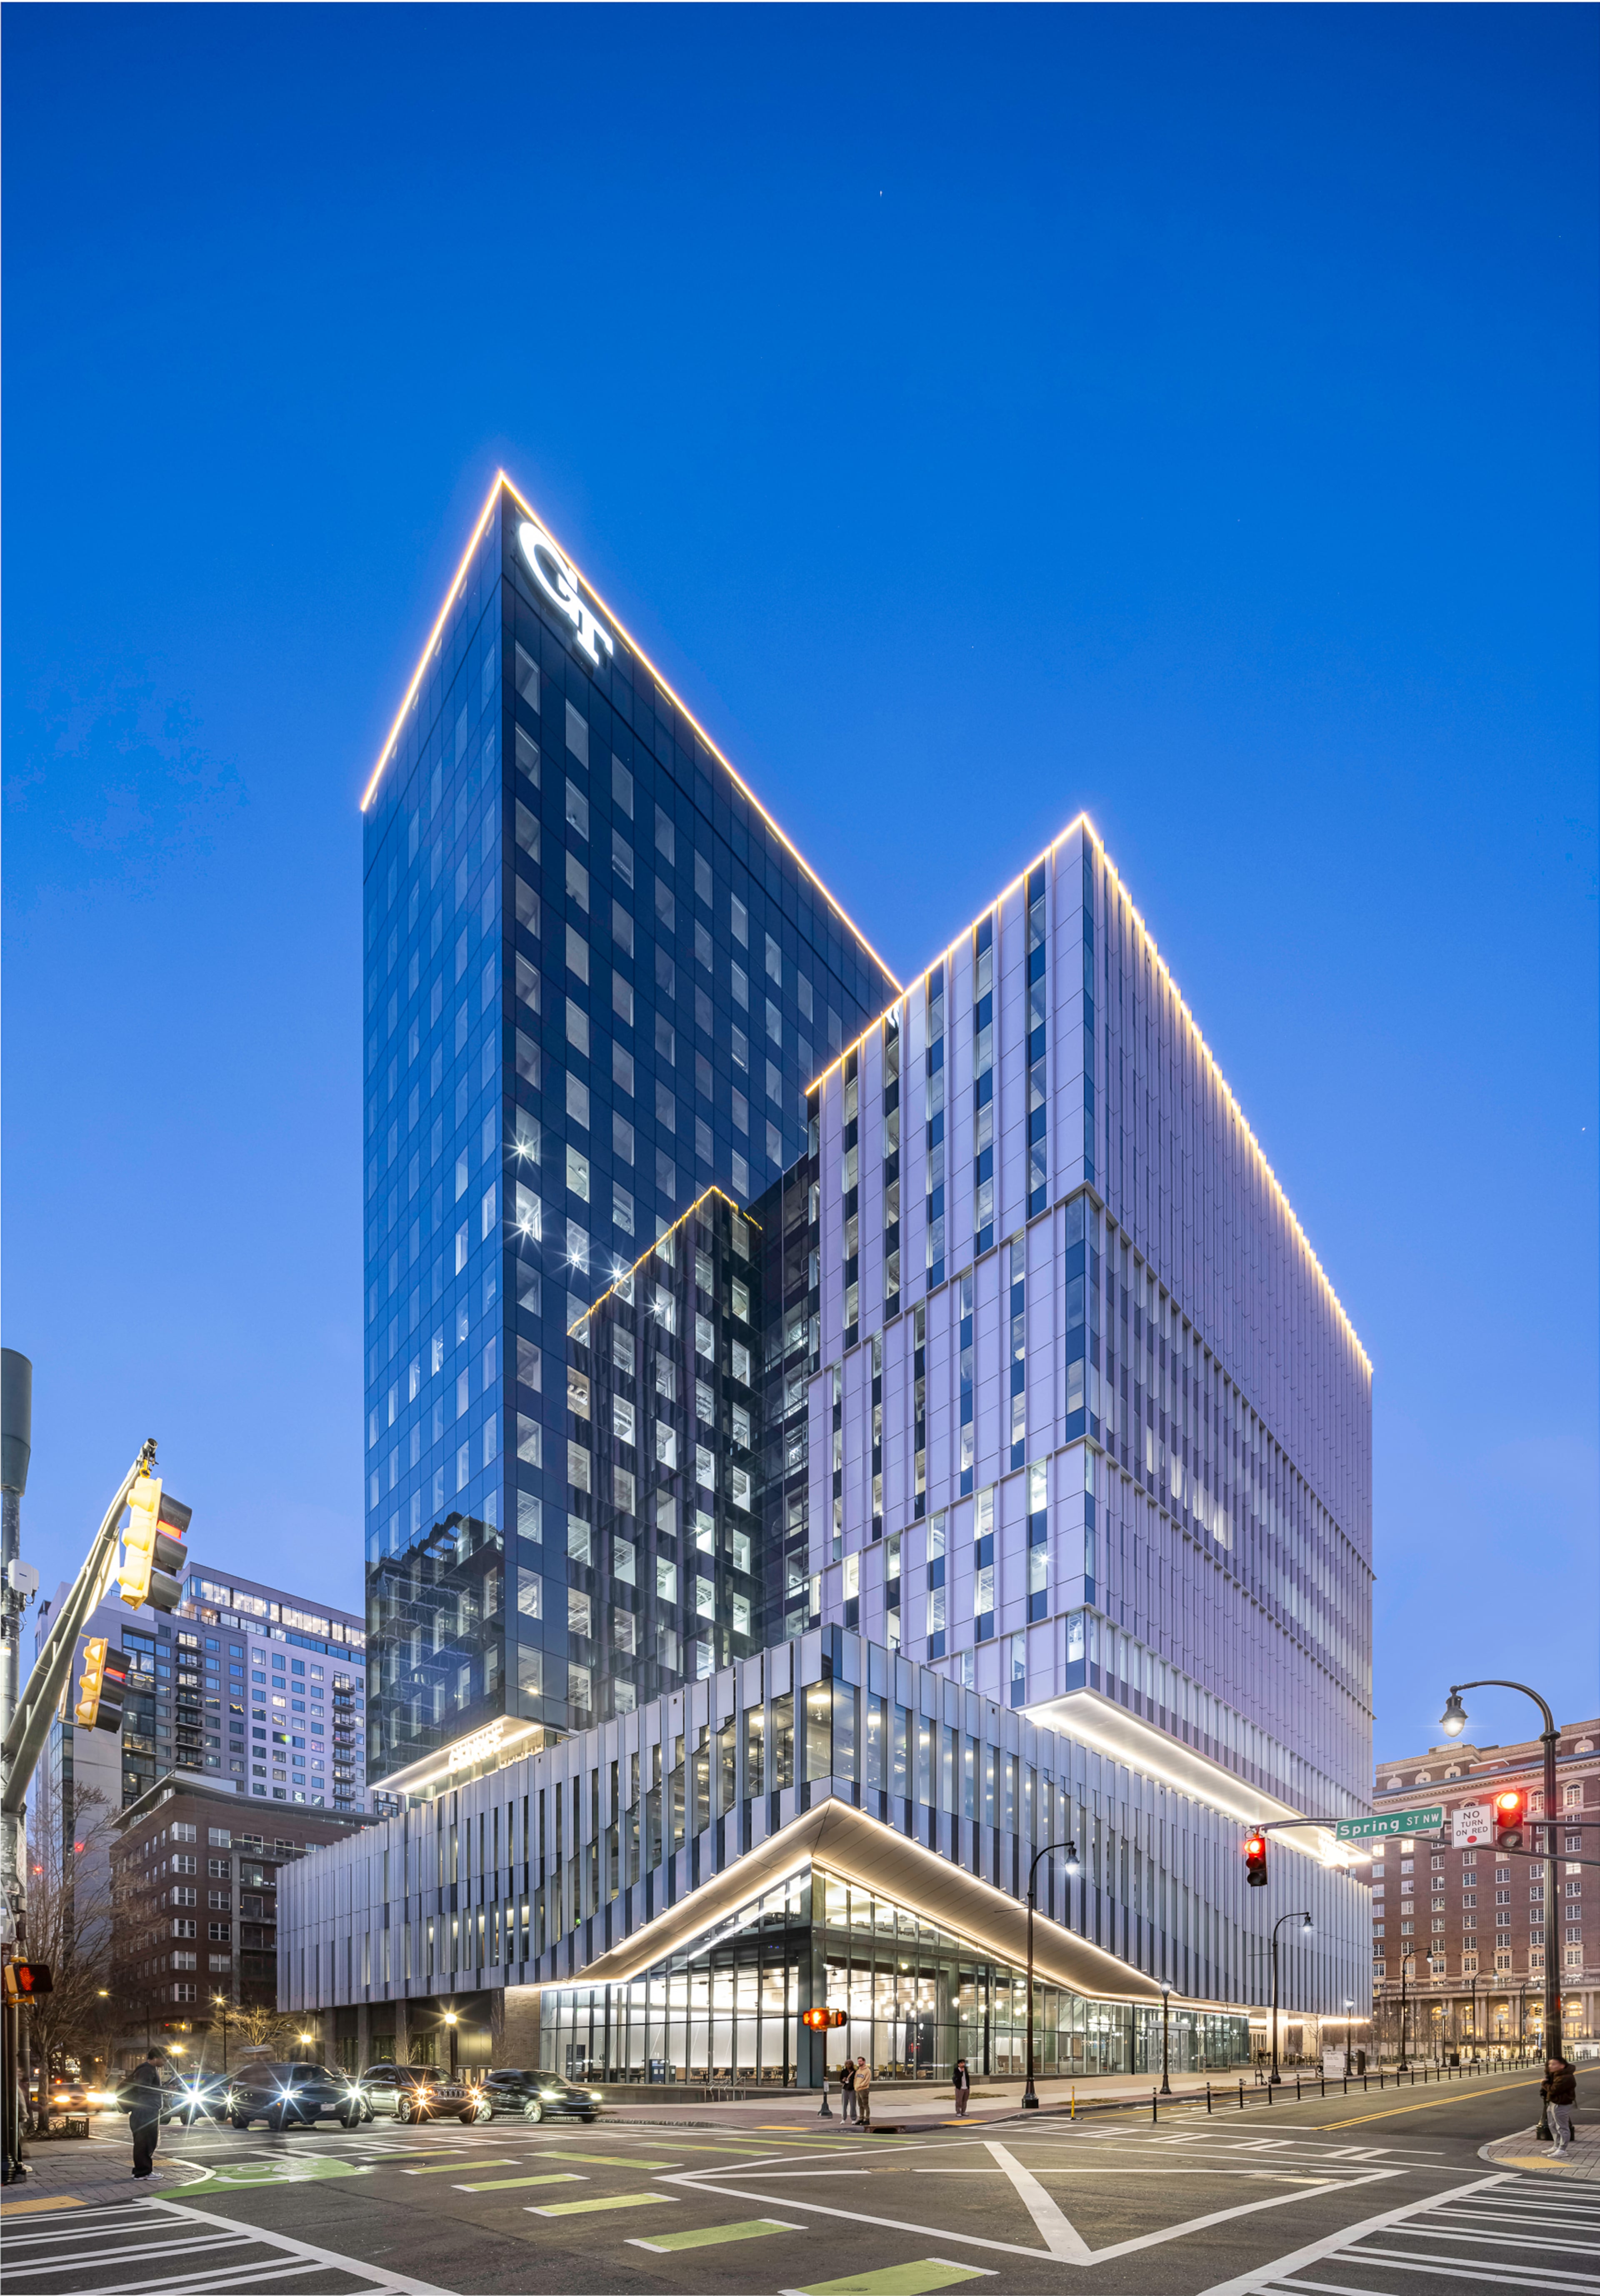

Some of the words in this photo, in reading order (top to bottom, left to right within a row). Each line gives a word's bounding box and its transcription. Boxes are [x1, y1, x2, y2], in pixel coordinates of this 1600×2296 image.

[519, 522, 613, 666] GT
[1463, 1811, 1480, 1819] NO
[1340, 1820, 1399, 1836] Spring
[1407, 1816, 1419, 1826] ST
[1423, 1813, 1439, 1824] NW
[1461, 1819, 1482, 1828] TURN
